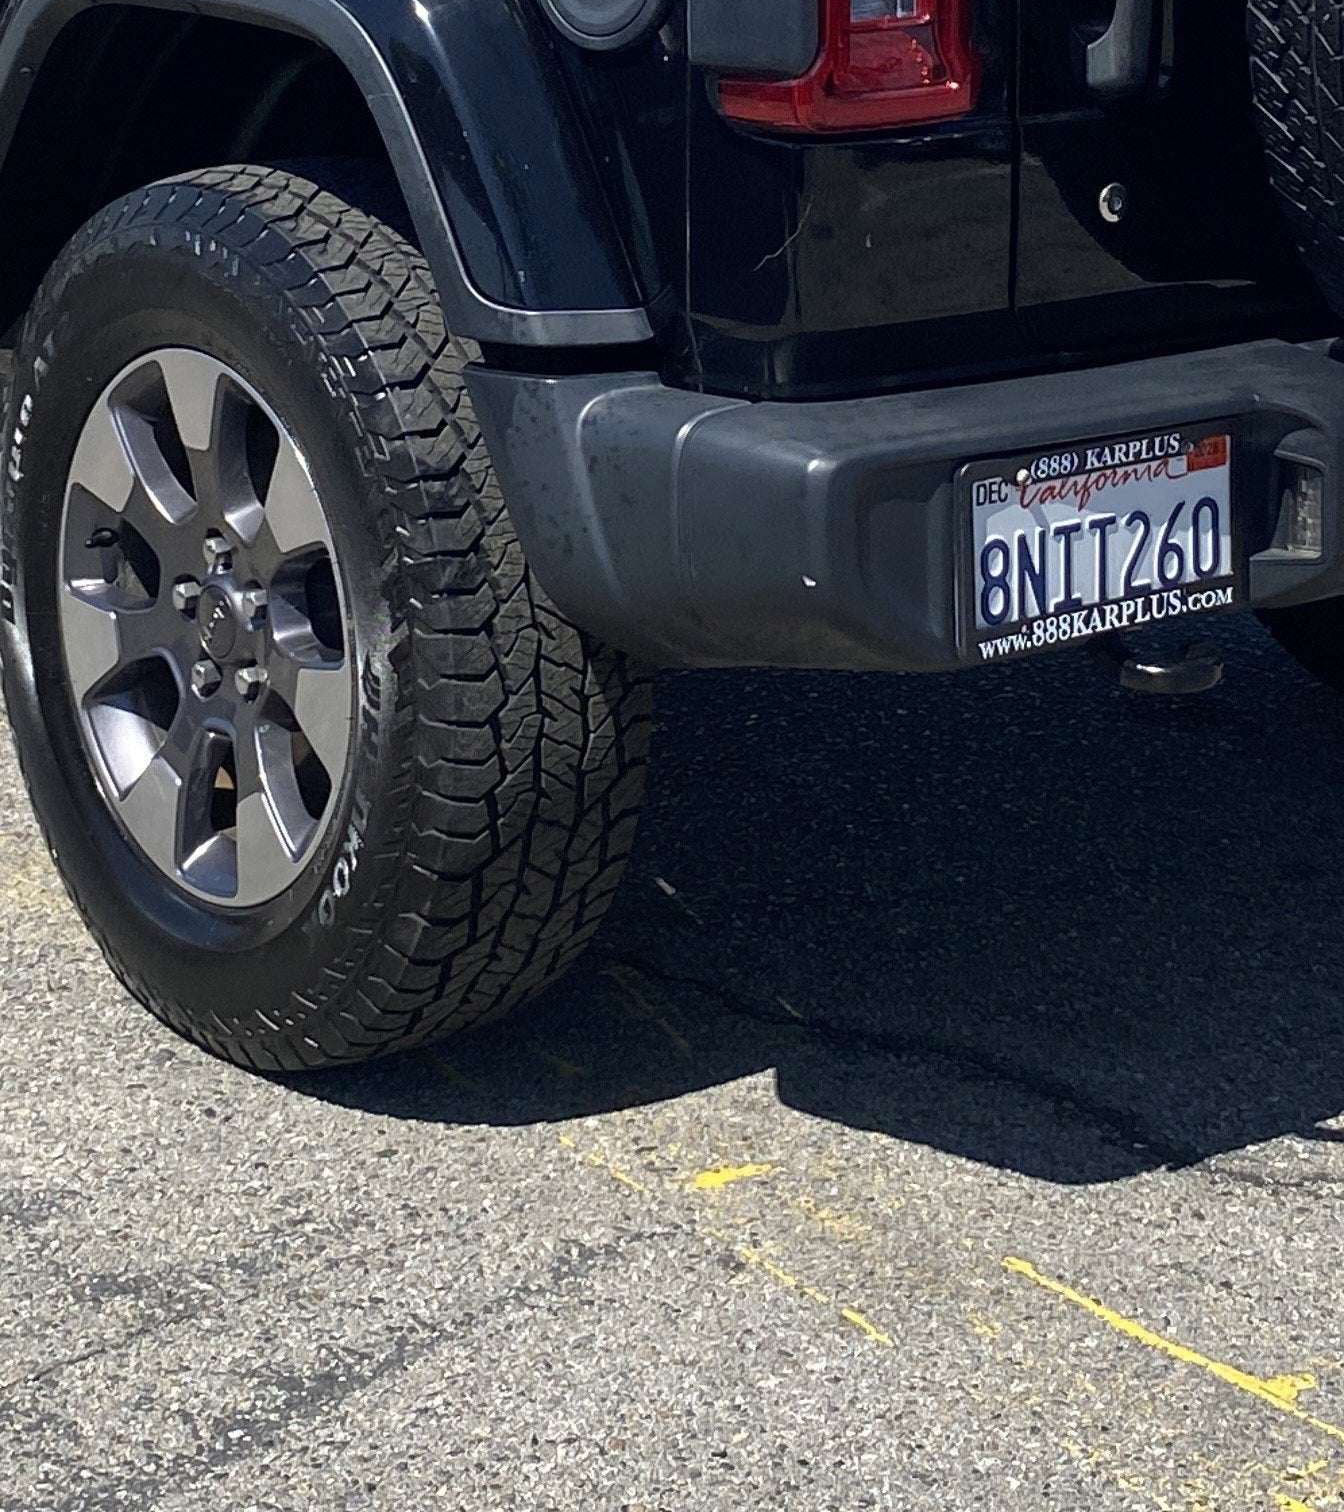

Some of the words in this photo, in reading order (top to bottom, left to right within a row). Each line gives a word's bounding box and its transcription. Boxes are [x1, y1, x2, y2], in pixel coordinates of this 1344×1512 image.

[975, 479, 1009, 507] DEC
[1017, 456, 1187, 512] California
[1030, 454, 1080, 480] (888)
[1084, 432, 1181, 471] KARPLUS
[980, 496, 1219, 626] 8NIT260
